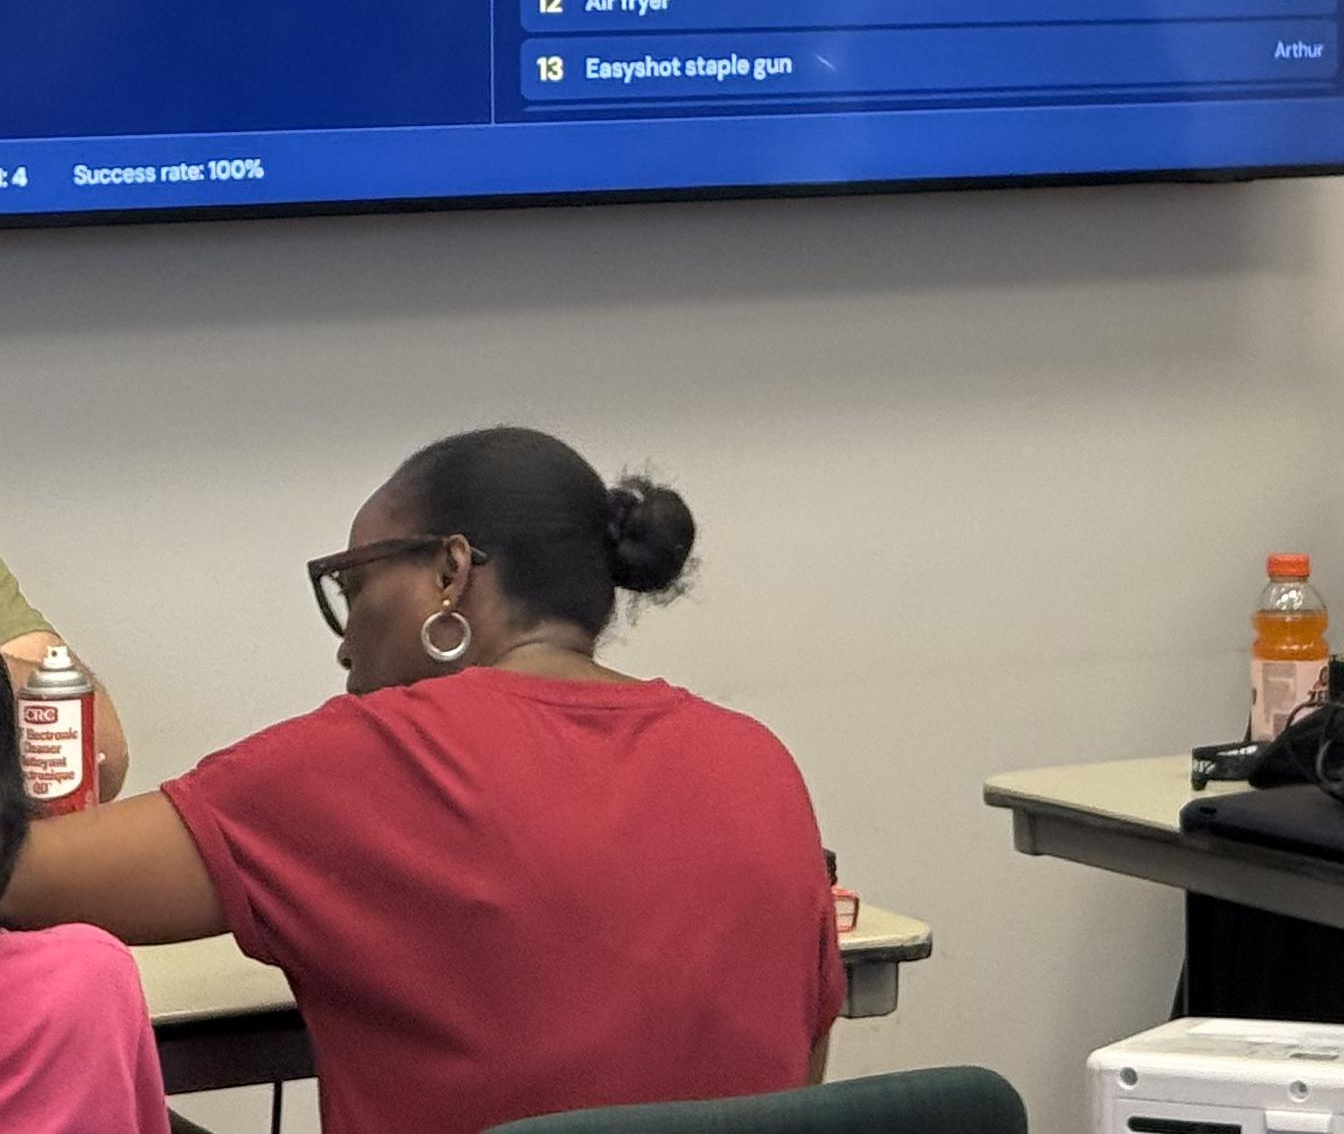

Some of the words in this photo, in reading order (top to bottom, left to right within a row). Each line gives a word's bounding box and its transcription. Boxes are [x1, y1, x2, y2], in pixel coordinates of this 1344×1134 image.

[1275, 42, 1323, 58] Arthur
[537, 57, 563, 81] 13
[586, 57, 681, 82] Easyshot
[685, 55, 749, 81] staple
[754, 56, 791, 80] gun
[11, 168, 27, 186] 4
[73, 165, 156, 185] Success
[161, 164, 204, 182] rate:
[208, 160, 264, 180] 100%
[26, 708, 56, 722] CRC
